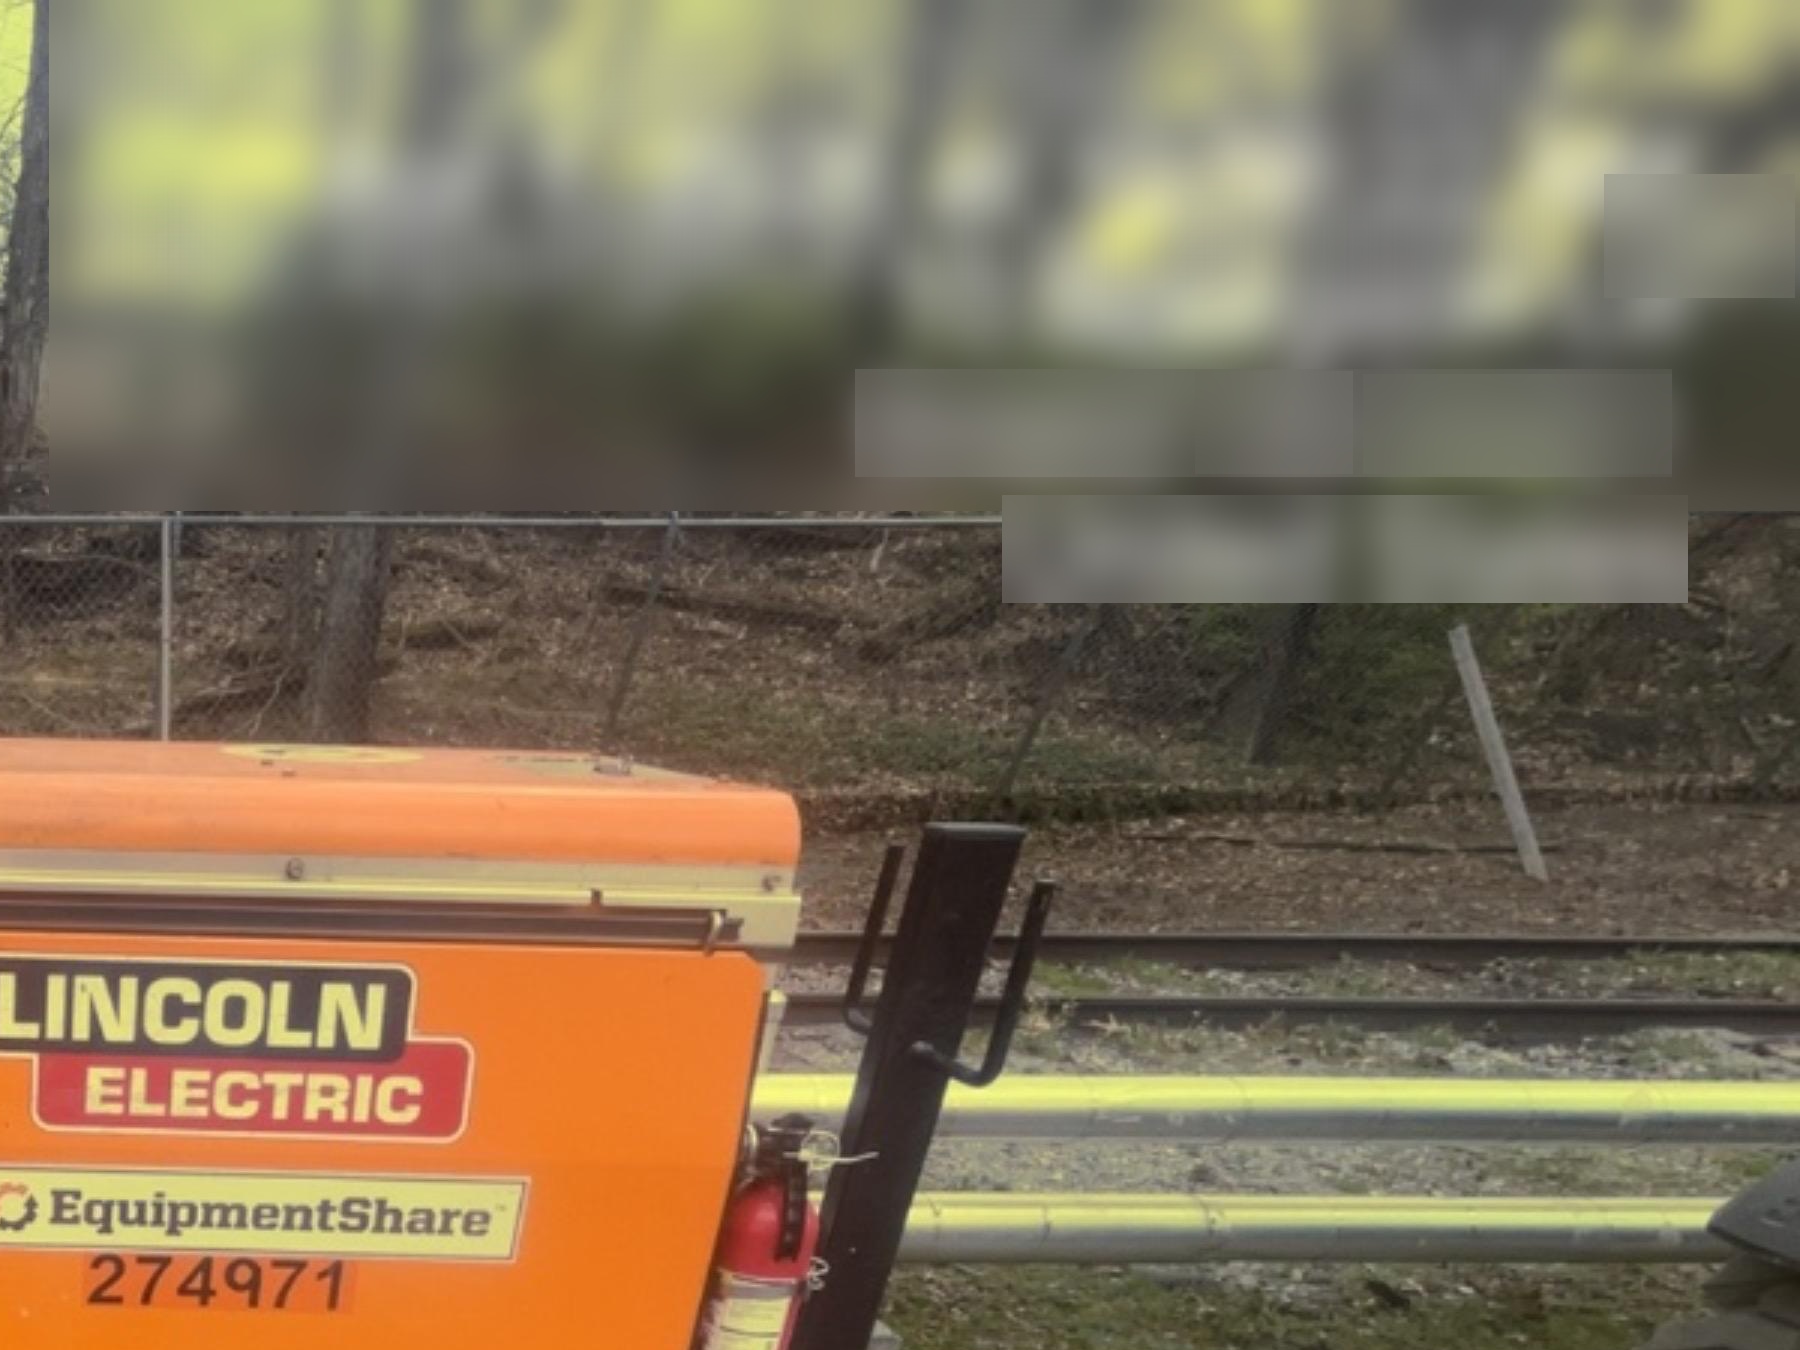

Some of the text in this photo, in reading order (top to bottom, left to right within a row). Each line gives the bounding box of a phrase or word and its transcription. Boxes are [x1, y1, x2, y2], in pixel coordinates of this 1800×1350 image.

[84, 1065, 424, 1126] ELECTRIC
[49, 1190, 492, 1237] EquipmentShare
[86, 1252, 345, 1311] 274971
